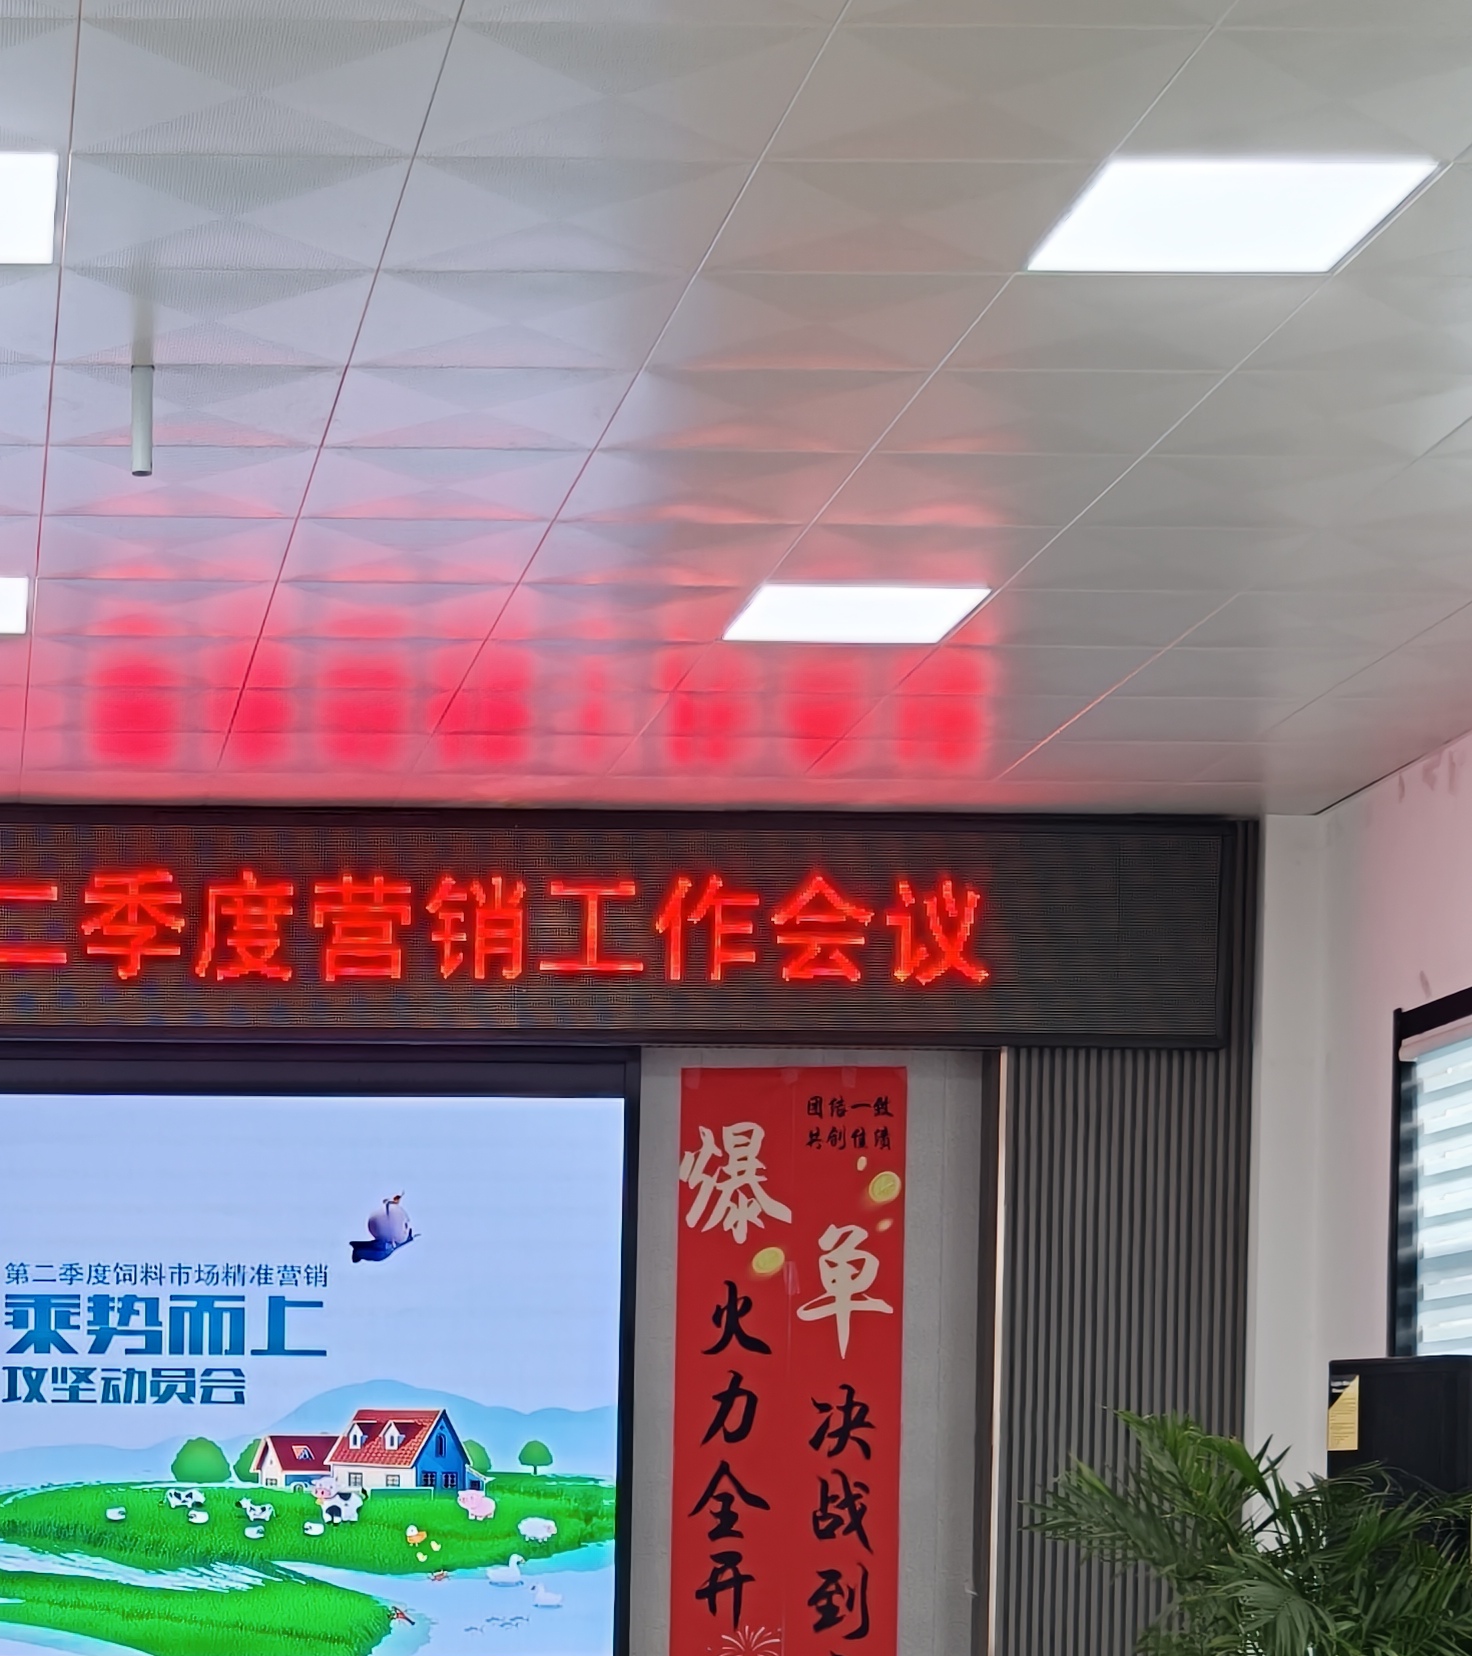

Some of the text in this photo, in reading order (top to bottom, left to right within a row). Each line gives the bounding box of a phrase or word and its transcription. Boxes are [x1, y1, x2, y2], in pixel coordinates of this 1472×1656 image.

[4, 1262, 329, 1287] 第二季度饲料市场精准营销
[4, 1293, 327, 1357] 乘势而上
[1, 1366, 245, 1405] 攻坚动员会
[689, 1280, 772, 1630] 火力全开
